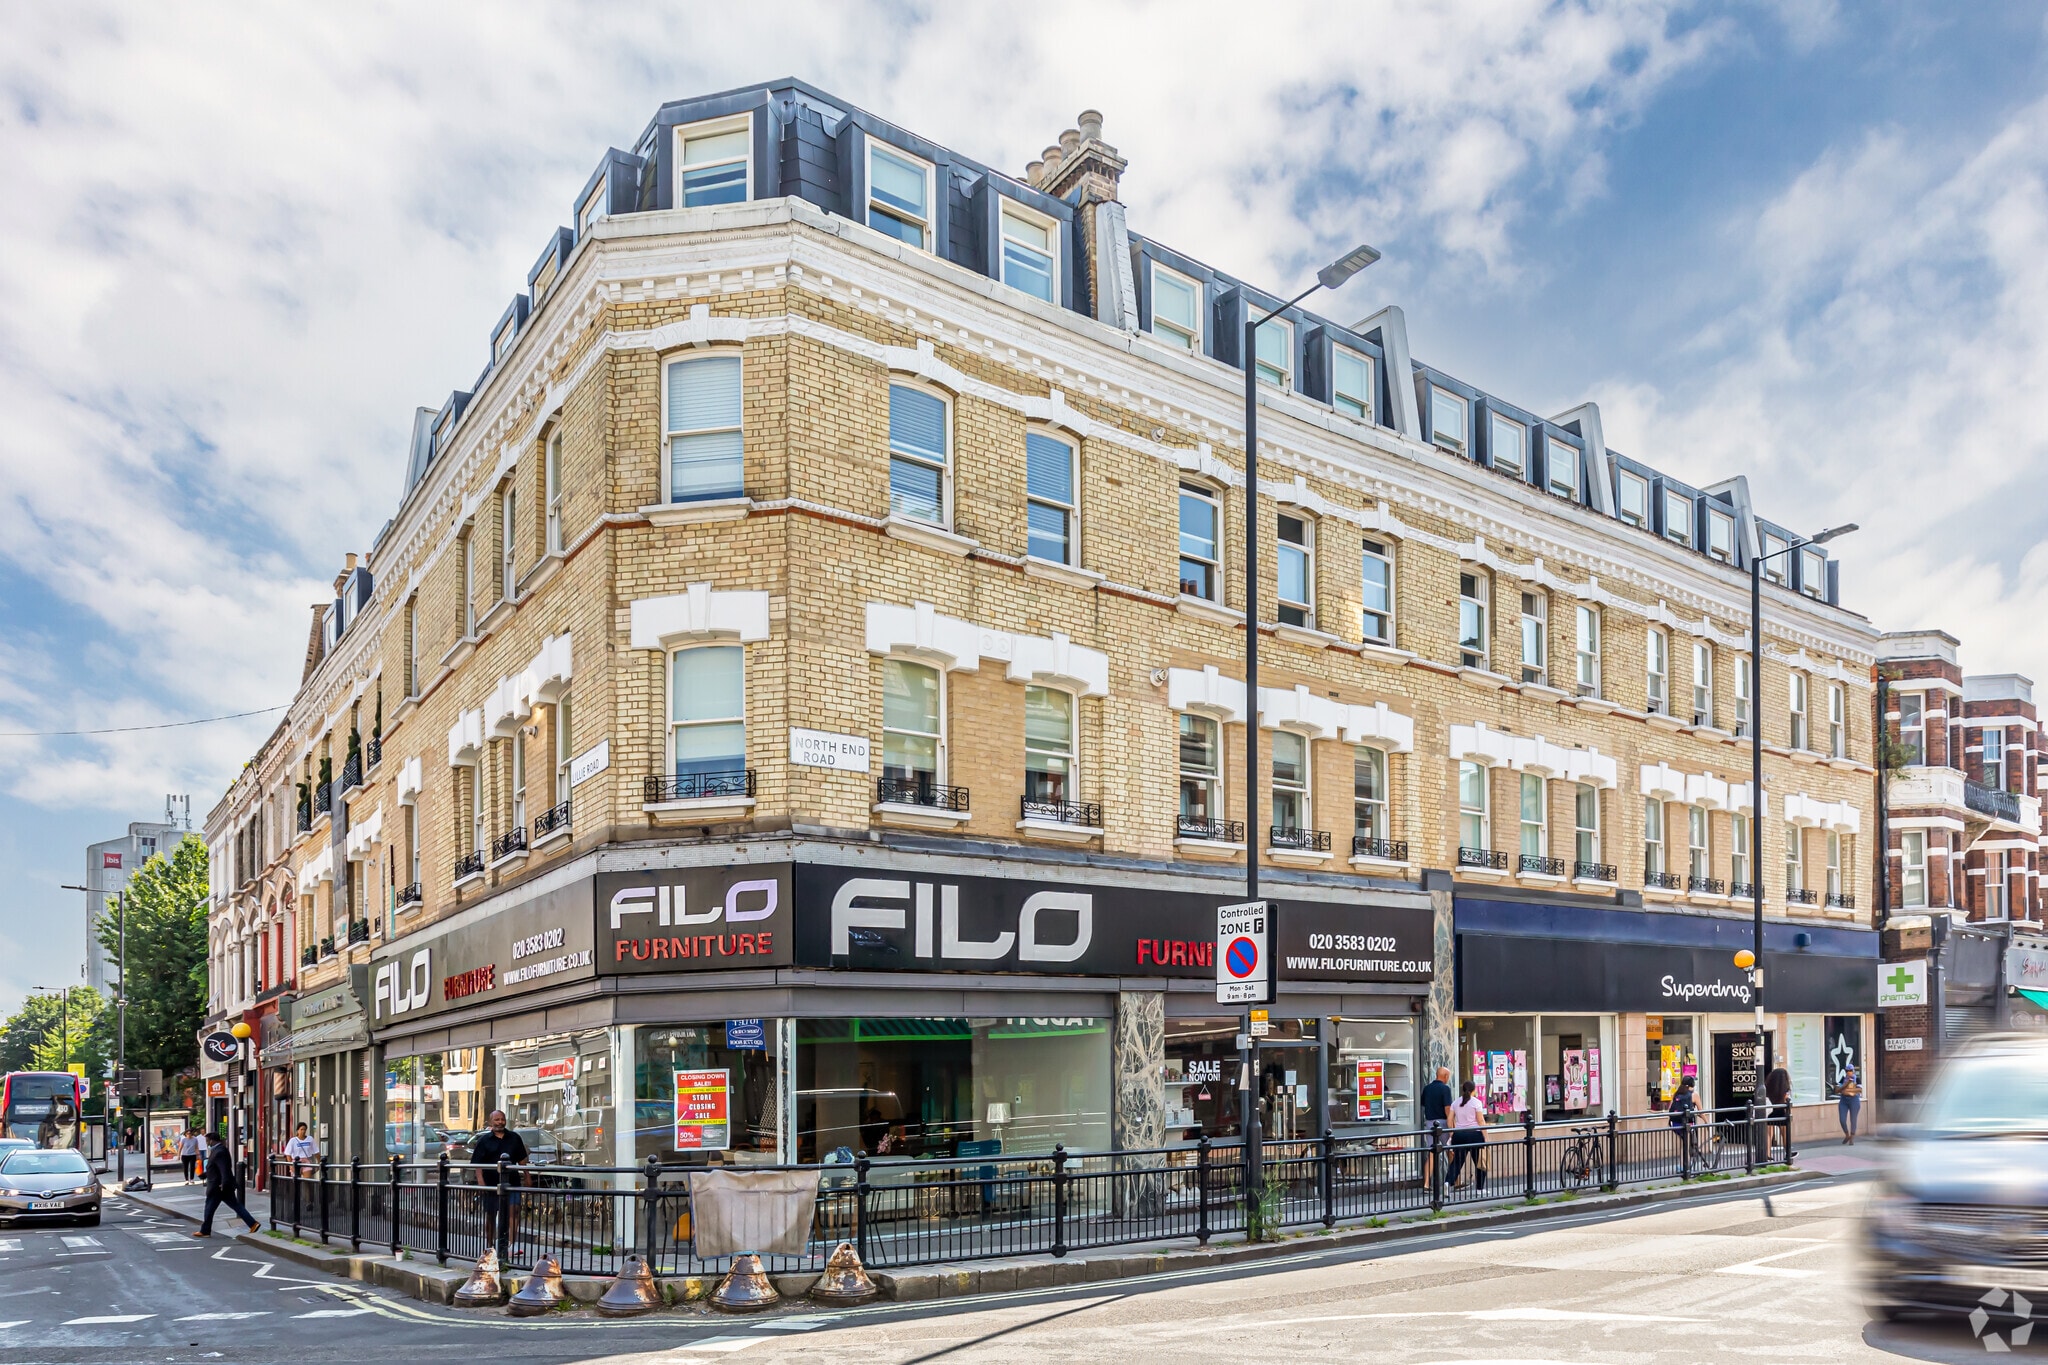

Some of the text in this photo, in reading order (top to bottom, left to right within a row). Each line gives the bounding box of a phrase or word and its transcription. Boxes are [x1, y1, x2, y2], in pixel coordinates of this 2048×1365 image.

[795, 736, 866, 756] NORTH END
[803, 751, 836, 766] ROAD
[572, 758, 599, 781] LILLIE ROAD
[106, 856, 120, 864] ibis
[610, 878, 779, 929] FILO
[1220, 905, 1264, 919] Controlled
[831, 877, 1217, 967] FILO FURNI
[1220, 919, 1263, 935] ZONE F
[512, 927, 565, 960] 020 3583 0202
[615, 931, 774, 962] FURNITURE
[1309, 933, 1396, 952] 020 3583 0202
[503, 949, 593, 986] WWW.FILOFURNITURE.CO.UK
[1286, 956, 1432, 973] WWW.FILOFURNITURE.CO.UK
[375, 948, 431, 1020] FILO
[443, 963, 496, 1000] FURNITURE
[1661, 975, 1751, 1004] Superdrug
[1880, 993, 1921, 1002] pharmacy
[1732, 1048, 1756, 1057] SKIN
[1188, 1060, 1221, 1074] SALE
[1495, 1063, 1505, 1076] £5
[1188, 1073, 1221, 1082] NOW ON!
[1732, 1075, 1757, 1083] FOOD
[692, 1093, 712, 1101] STORE
[688, 1102, 716, 1110] CLOSING
